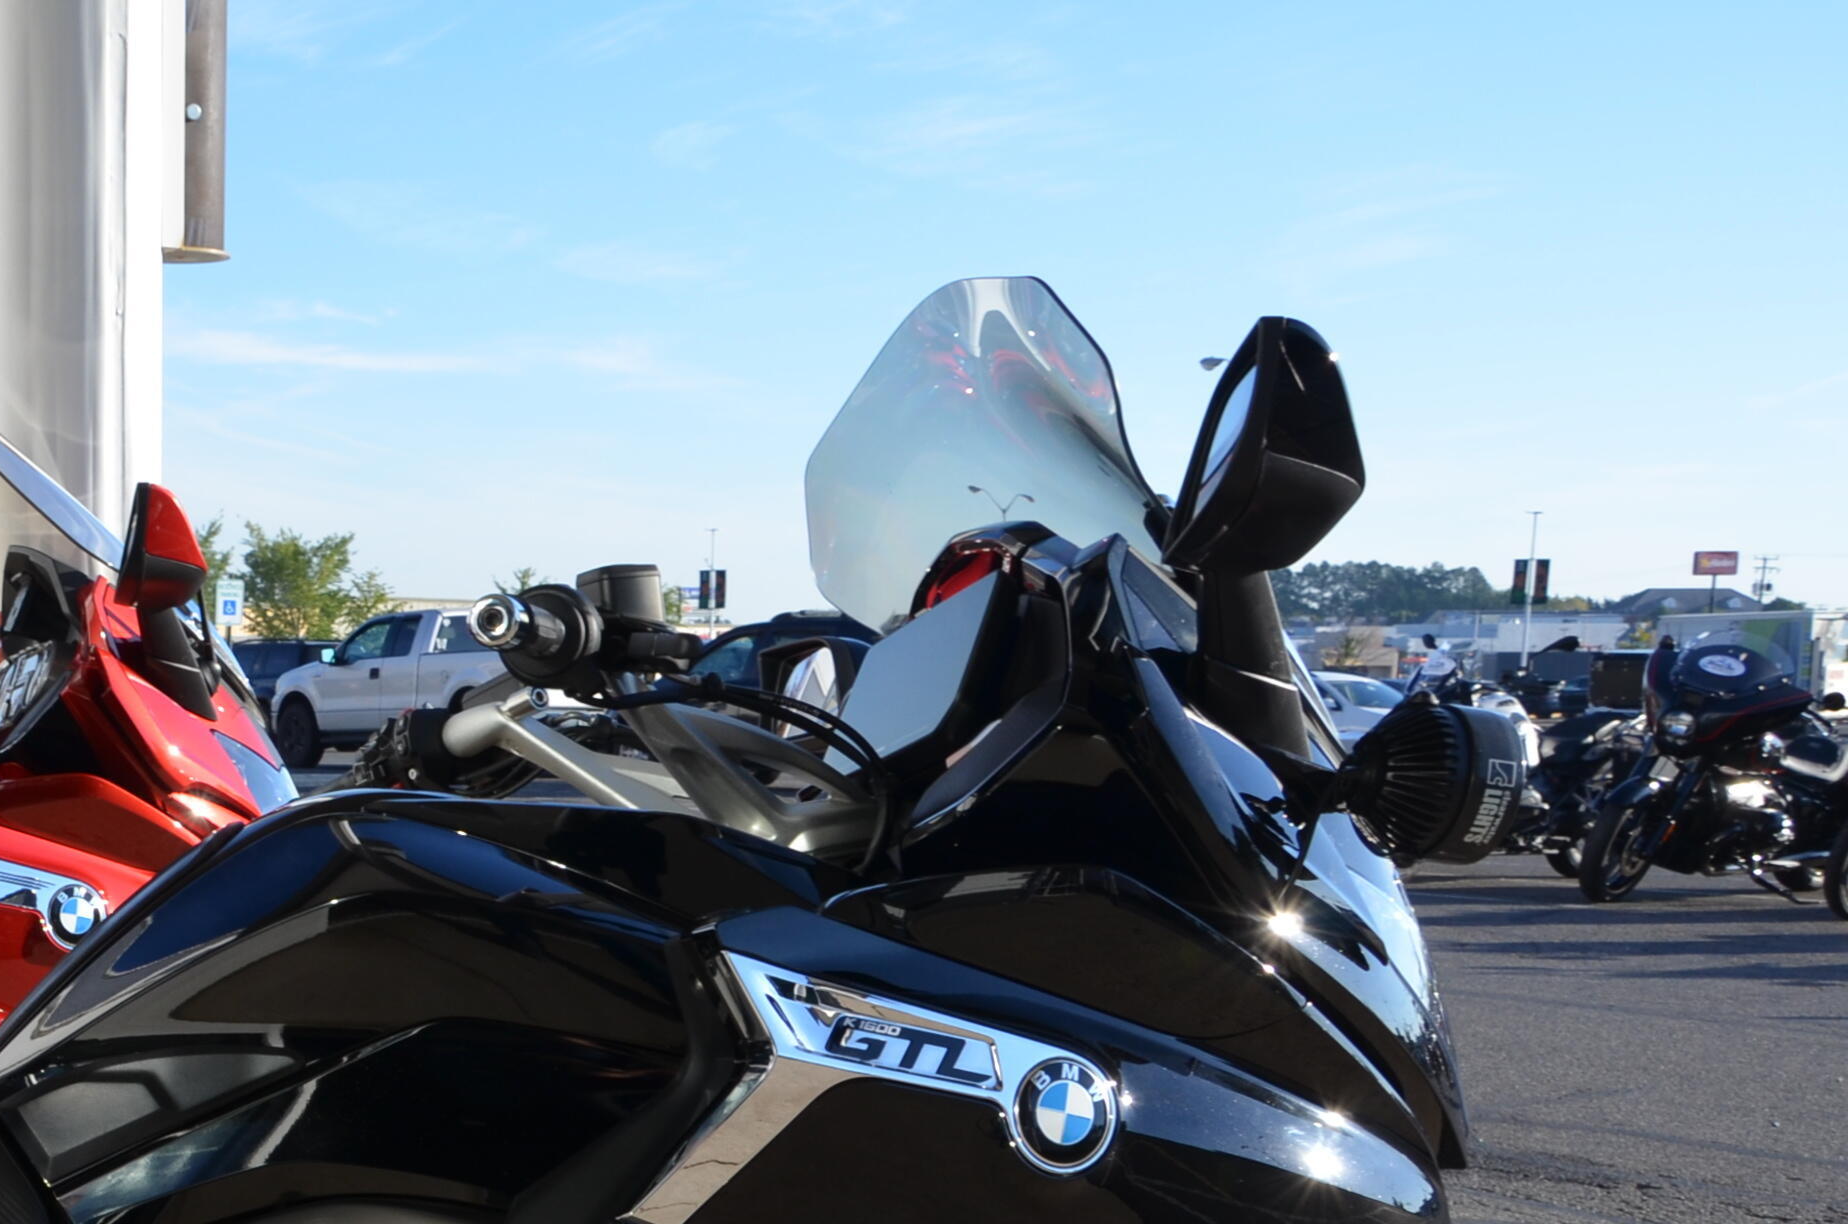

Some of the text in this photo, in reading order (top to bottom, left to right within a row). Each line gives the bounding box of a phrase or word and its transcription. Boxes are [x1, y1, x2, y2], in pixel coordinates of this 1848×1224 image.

[1463, 787, 1503, 845] LIGHTS
[825, 1016, 992, 1083] GTL
[842, 1017, 902, 1037] K 1600
[1032, 1062, 1107, 1103] BMW
